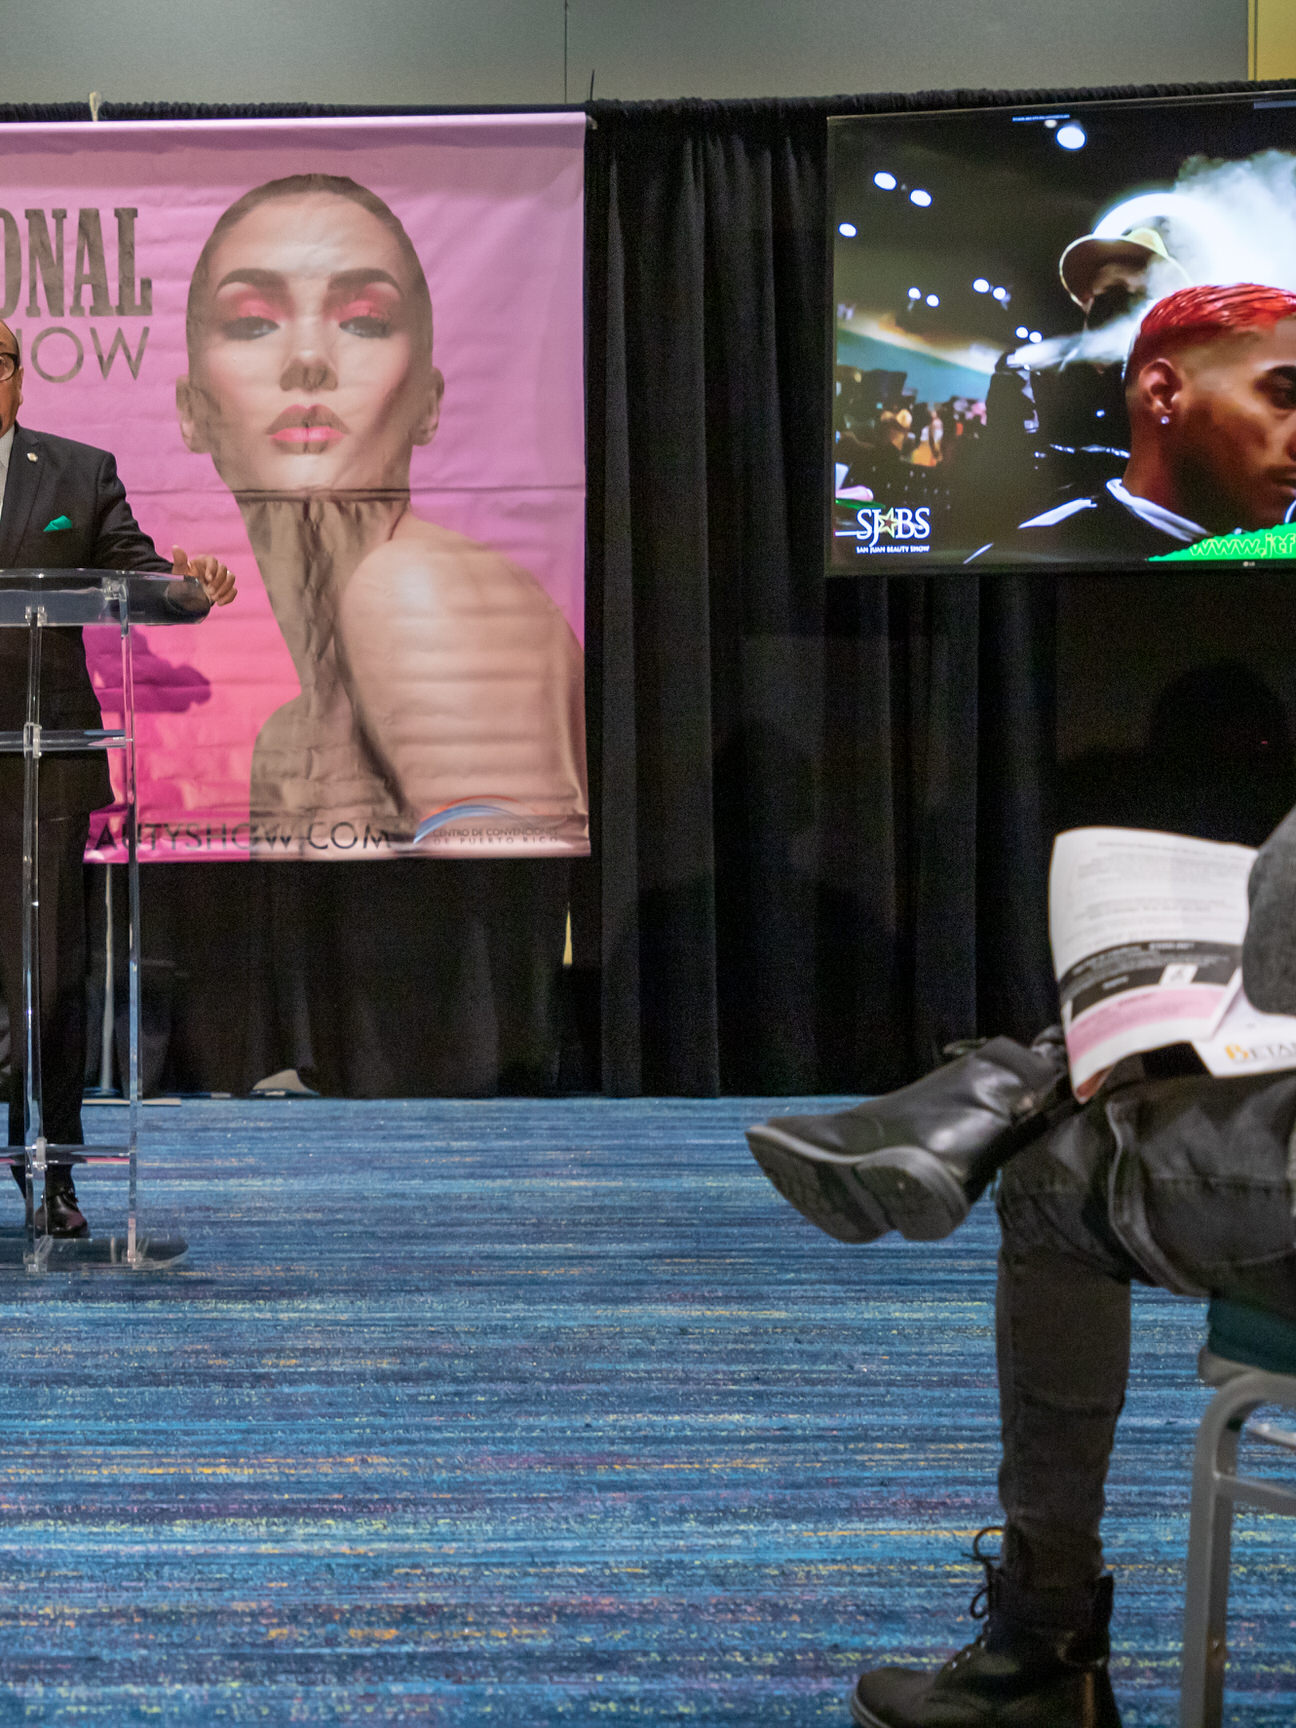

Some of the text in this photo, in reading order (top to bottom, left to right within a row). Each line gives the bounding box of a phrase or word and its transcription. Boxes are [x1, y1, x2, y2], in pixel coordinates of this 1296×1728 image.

[16, 326, 150, 384] OW
[432, 828, 469, 837] CENTRO
[471, 828, 484, 837] DE
[460, 836, 514, 844] PUERTO
[522, 836, 558, 844] RICO
